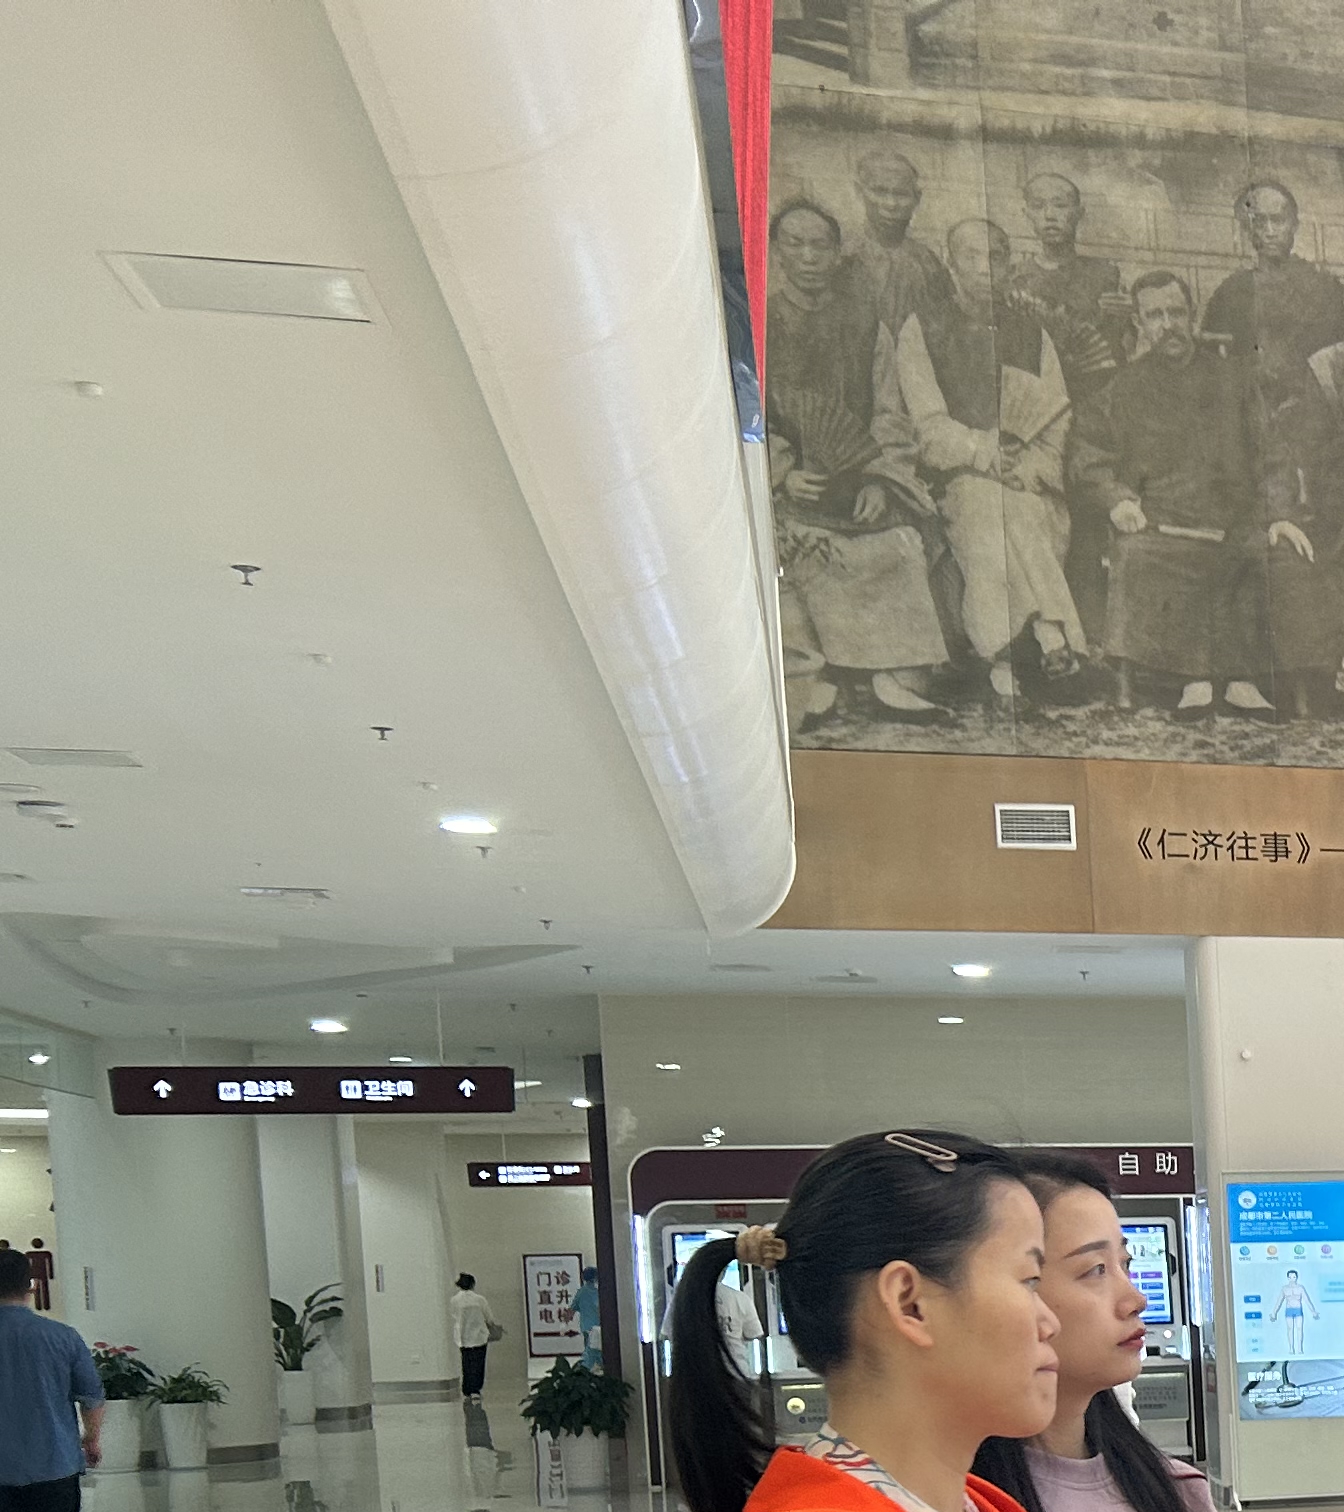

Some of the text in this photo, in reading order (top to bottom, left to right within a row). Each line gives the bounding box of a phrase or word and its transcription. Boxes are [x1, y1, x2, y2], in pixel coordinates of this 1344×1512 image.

[364, 1080, 414, 1096] 卫生间
[1118, 1151, 1178, 1176] 自助
